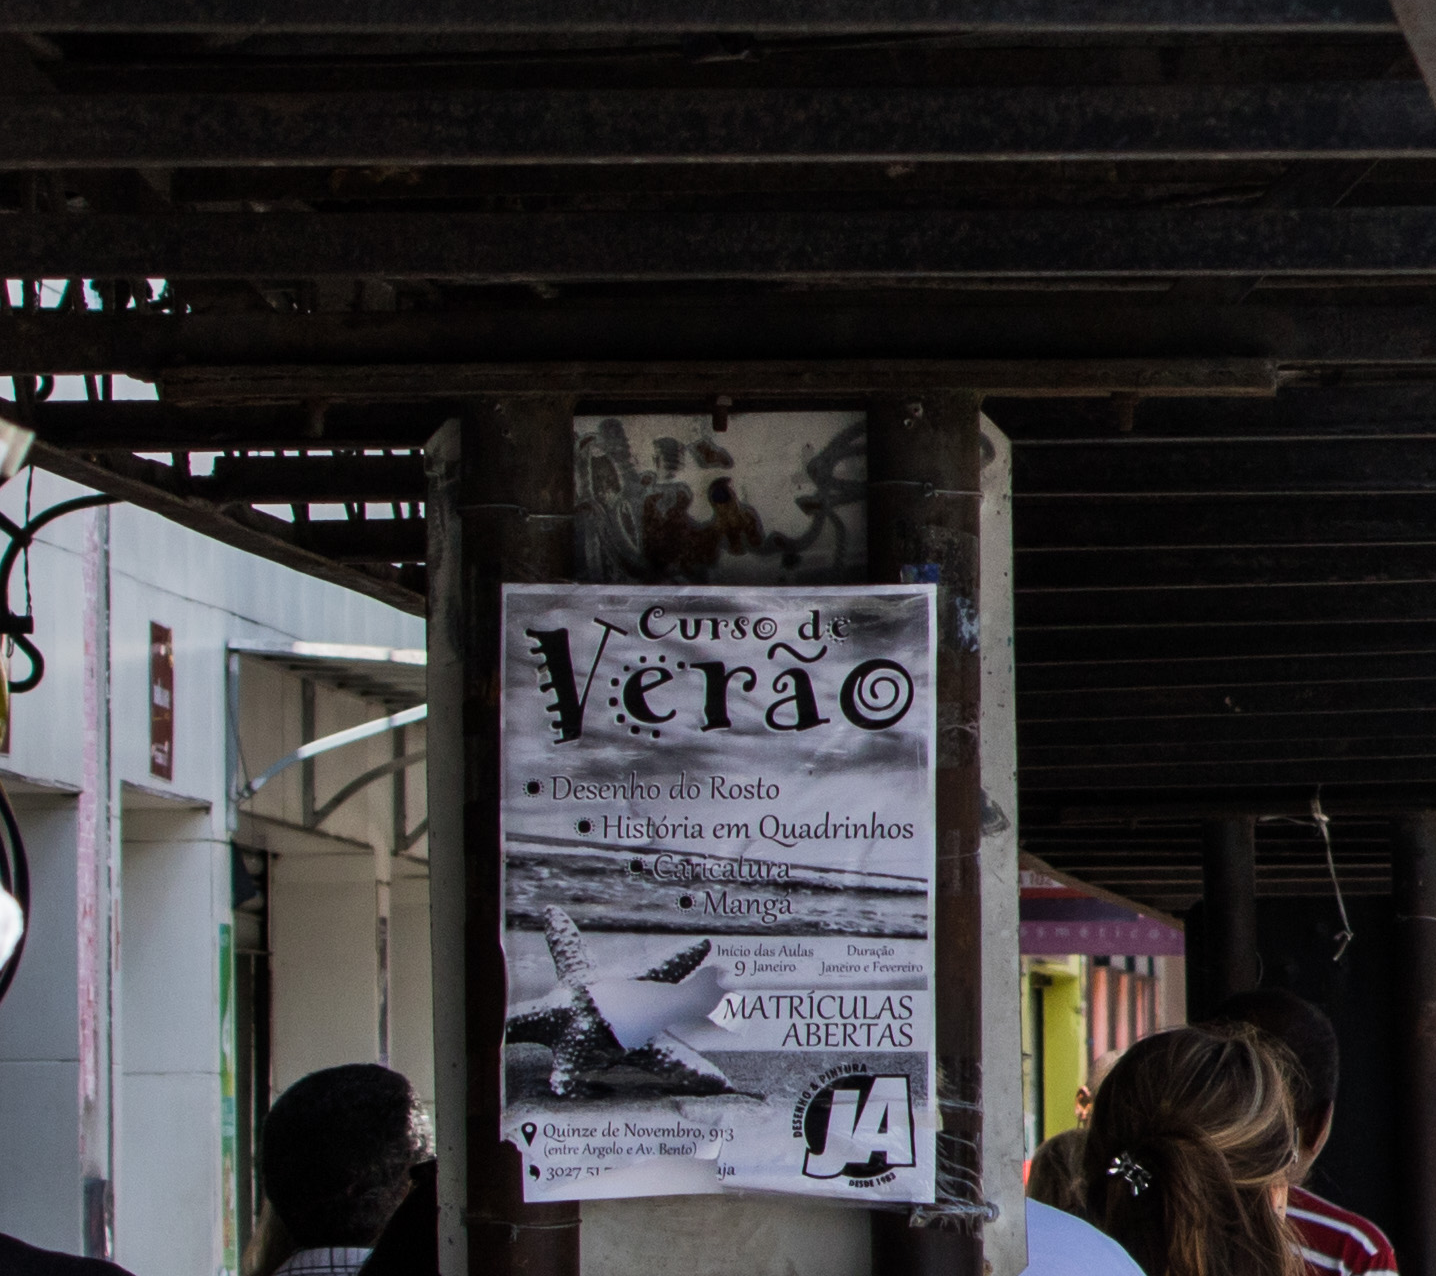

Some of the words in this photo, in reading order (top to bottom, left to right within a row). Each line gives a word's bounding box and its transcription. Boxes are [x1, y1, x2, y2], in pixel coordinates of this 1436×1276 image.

[639, 606, 777, 640] Curso
[797, 610, 850, 645] de
[525, 617, 914, 744] Verão
[551, 770, 660, 800] Desenho
[669, 770, 700, 800] do
[711, 776, 780, 800] Rosto
[601, 814, 704, 839] História
[713, 823, 751, 839] em
[759, 811, 914, 847] Quadrinhos
[654, 854, 790, 881] Caricatura
[703, 889, 793, 924] Mangá
[717, 945, 750, 957] Início
[754, 943, 776, 957] das
[779, 944, 814, 957] Aulas
[847, 945, 895, 958] Duração
[735, 960, 746, 976] 9
[751, 960, 797, 976] Janeiro
[819, 961, 861, 976] Janeiro
[864, 964, 870, 972] e
[873, 961, 923, 973] Fevereiro
[723, 990, 913, 1020] MATRÍCULAS
[781, 1022, 913, 1047] ABERTAS
[792, 1091, 811, 1138] DESENHO
[819, 1063, 867, 1083] PINTURA
[543, 1123, 597, 1142] Quinze
[602, 1122, 618, 1137] de
[624, 1122, 705, 1141] Novembro,
[709, 1128, 735, 1142] 913
[802, 1074, 916, 1180] JA
[543, 1143, 579, 1158] (entre
[581, 1143, 623, 1158] Argolo
[627, 1146, 633, 1155] e
[636, 1143, 655, 1155] Av.
[659, 1142, 697, 1157] Bento)
[546, 1166, 581, 1181] 3027
[849, 1179, 874, 1188] DESDE
